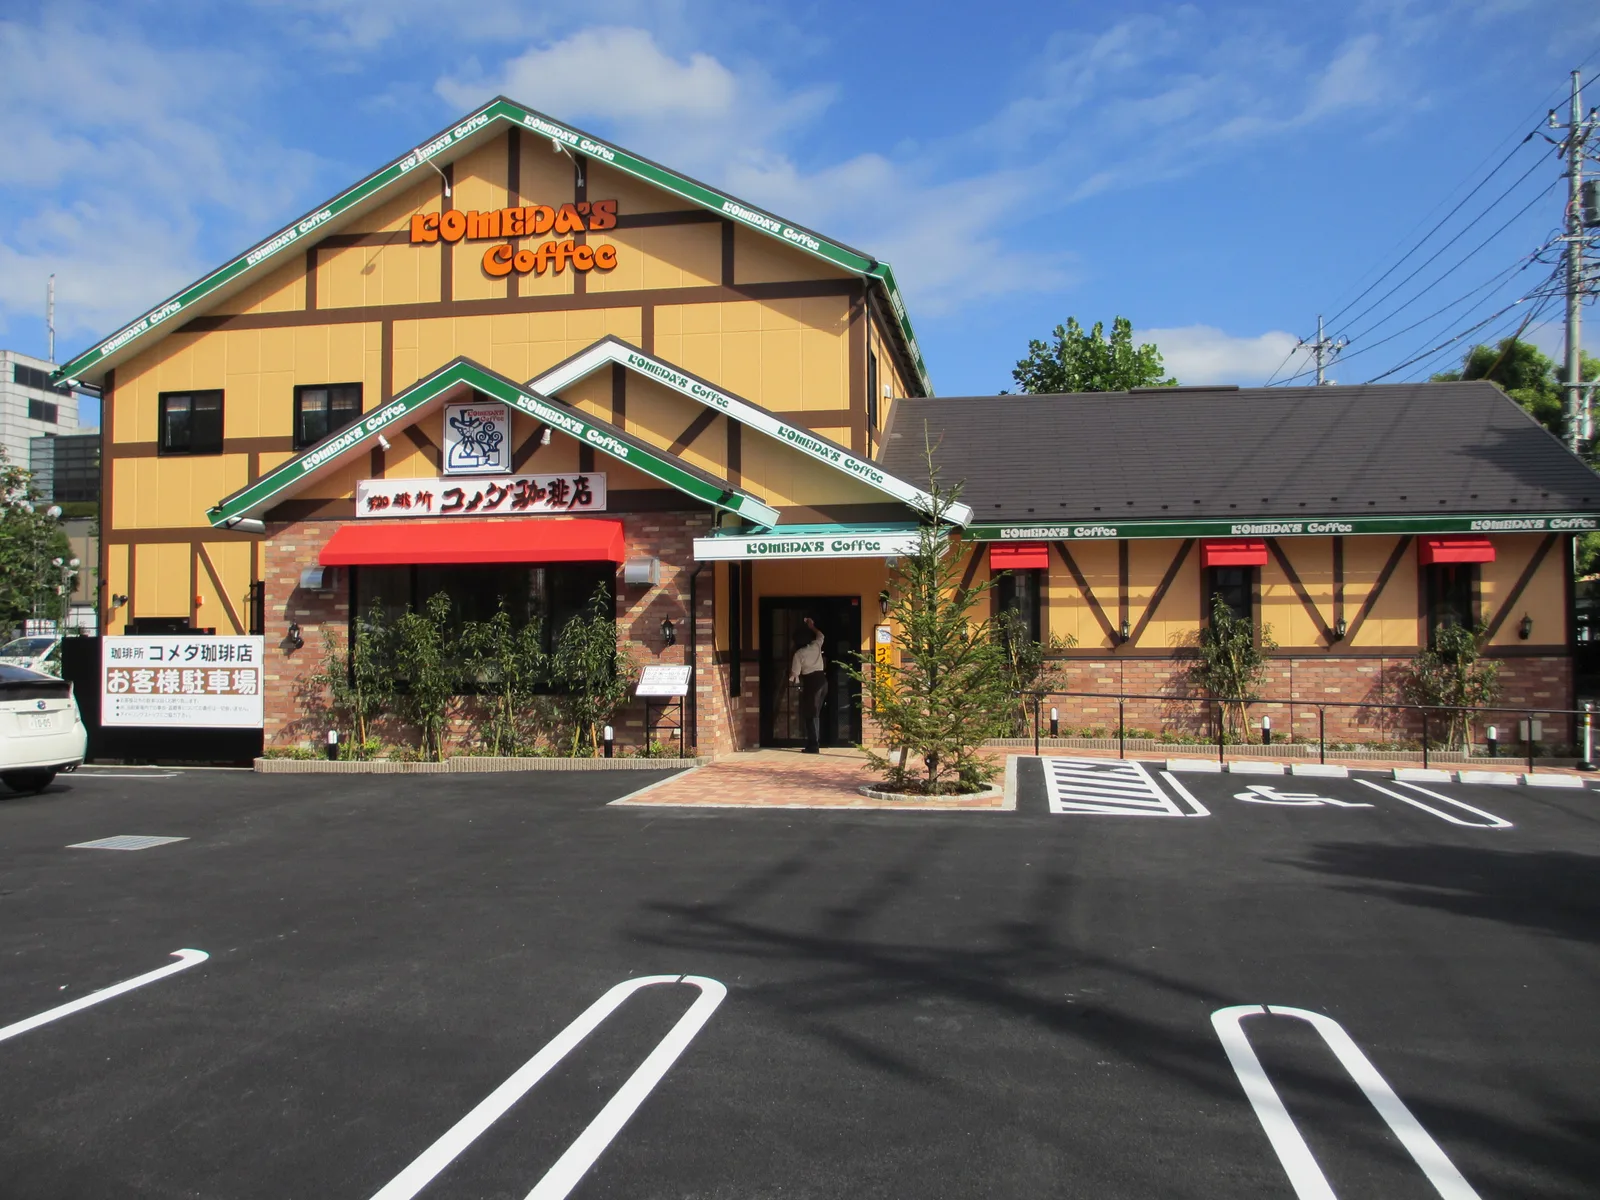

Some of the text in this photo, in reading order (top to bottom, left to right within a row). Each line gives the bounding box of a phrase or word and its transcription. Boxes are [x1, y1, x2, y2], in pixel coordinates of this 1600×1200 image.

[399, 114, 488, 172] KOEDA'S Coffee
[523, 114, 615, 161] KOMEDA'S Coffee
[246, 210, 332, 265] KOMEDA'S Coffee
[410, 199, 618, 243] KOMEDA'S
[722, 201, 820, 251] KOMEDA'S Coffee
[482, 240, 618, 277] Coffee
[101, 302, 181, 355] KOMEDA'S Coffee
[627, 354, 729, 409] KOMEDA'S Coffee
[302, 402, 406, 471] KOMEDA'S Coffee
[517, 394, 629, 458] KOMEDA'S Coffee
[777, 426, 884, 484] KOMEDA'S Coffee
[440, 475, 594, 513] コメダ珈琲店
[746, 540, 881, 554] KOMEDA'S Coffee
[1000, 527, 1118, 539] KOMEDA'S Coffee
[1231, 522, 1353, 535] KOMEDA'S Coffee
[1470, 518, 1597, 531] KOMEDA'S Coffee
[111, 643, 253, 663] 珈琲所 コメダ珈琲店
[107, 669, 257, 695] お客様駐車場
